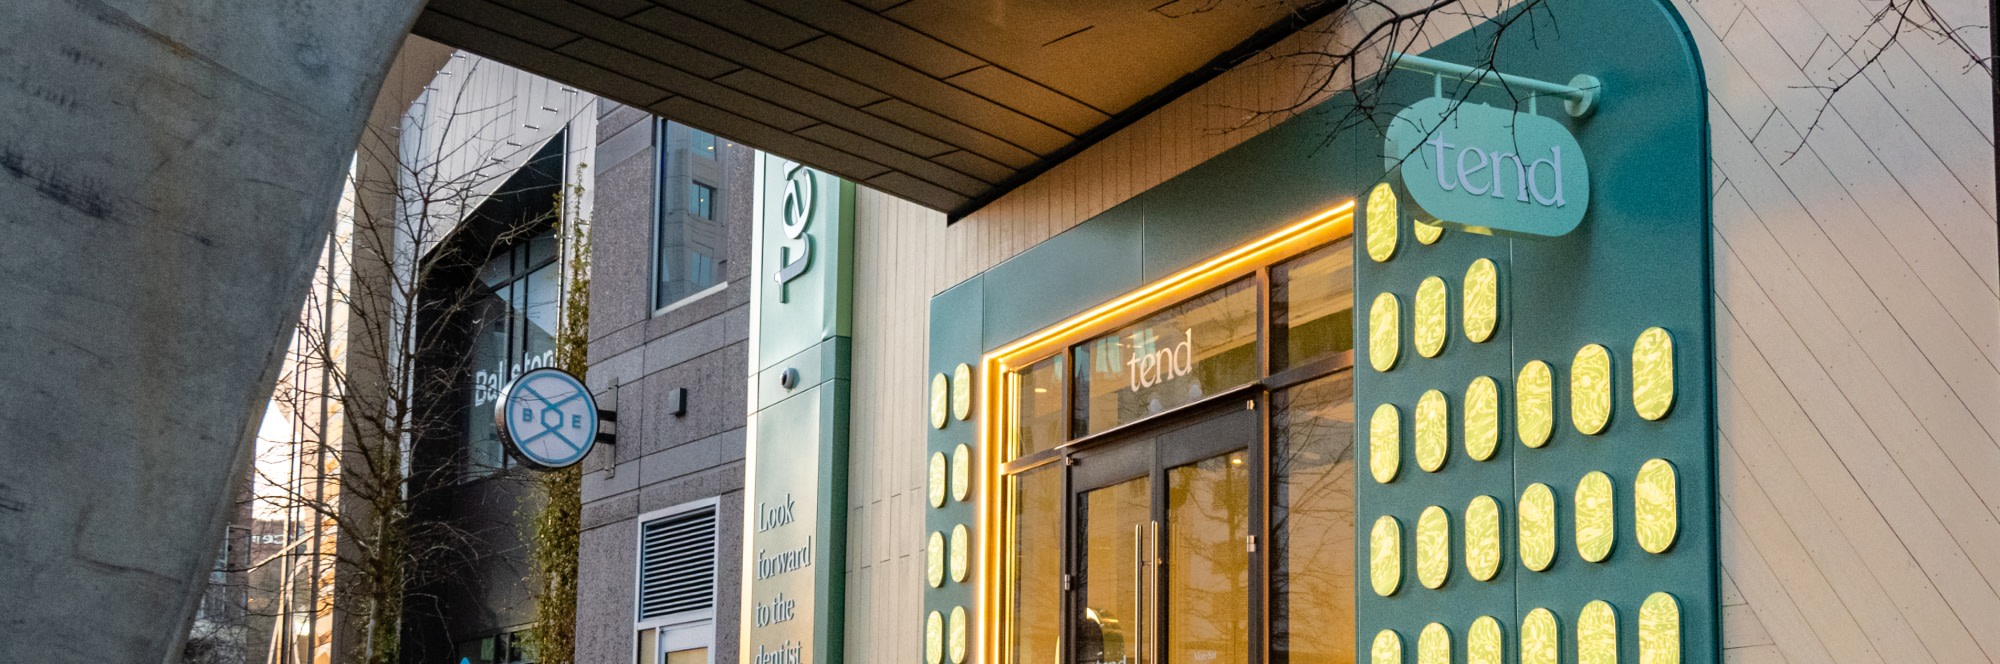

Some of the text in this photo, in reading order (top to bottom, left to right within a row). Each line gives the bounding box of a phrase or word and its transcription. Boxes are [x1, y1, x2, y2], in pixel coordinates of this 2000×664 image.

[1426, 131, 1566, 207] tend
[774, 160, 812, 303] te
[1127, 328, 1192, 392] tend
[758, 493, 795, 533] Look
[757, 535, 811, 580] forward
[755, 592, 795, 628] to the
[754, 640, 802, 664] dentist
